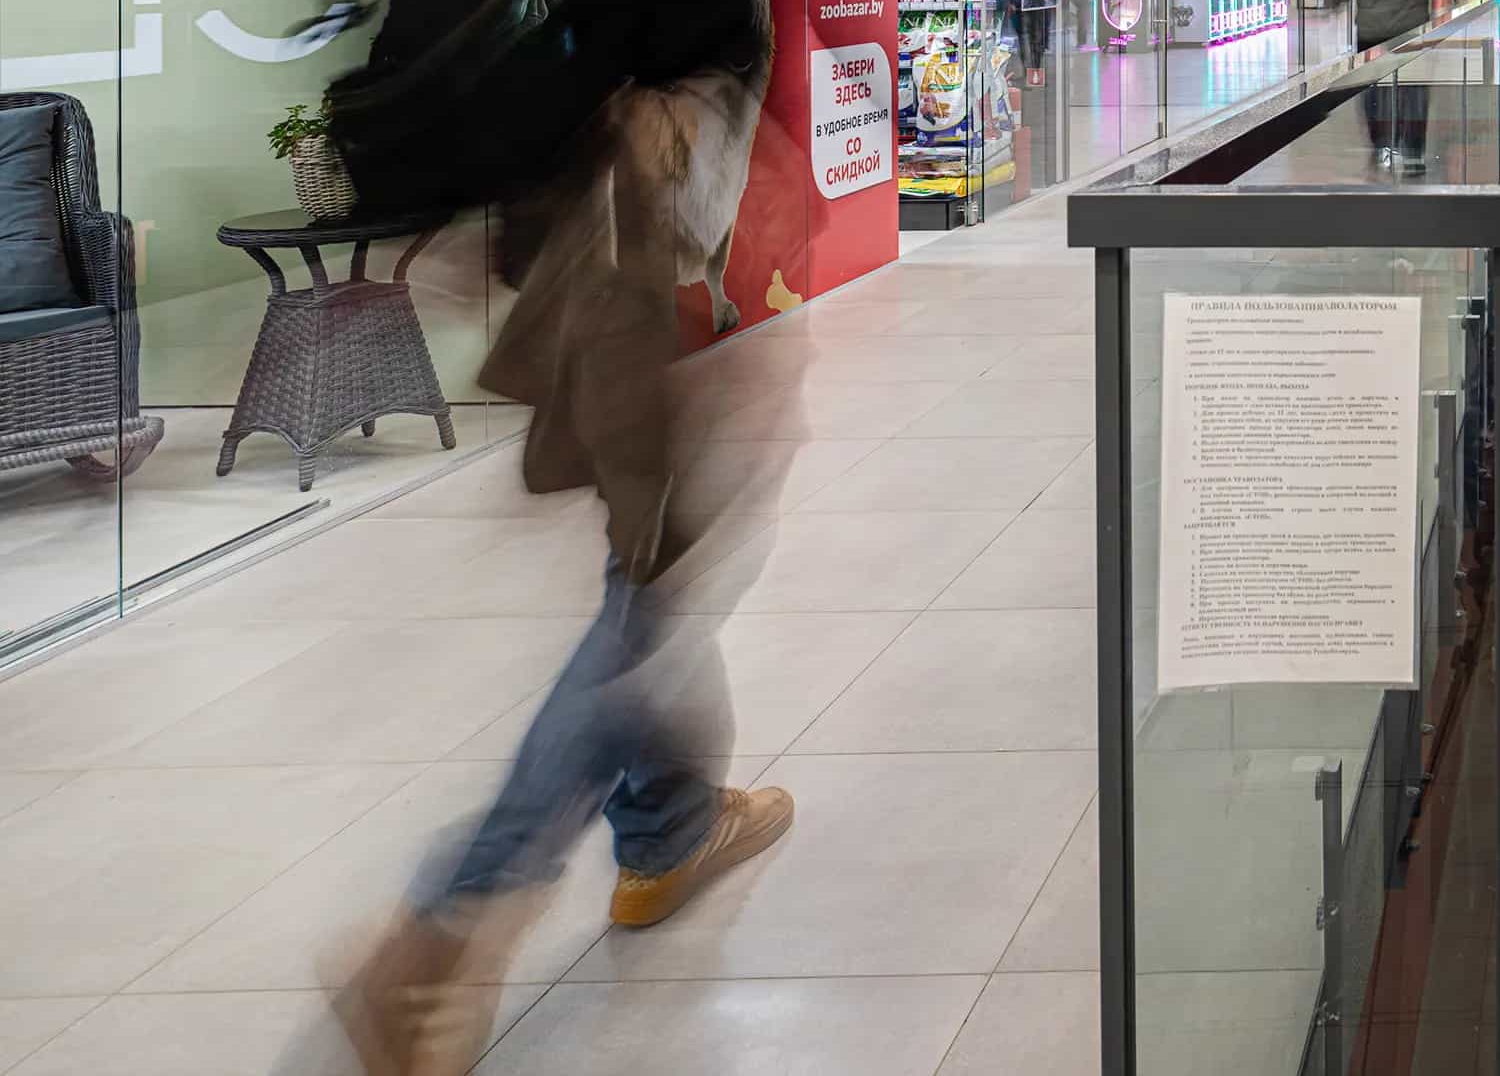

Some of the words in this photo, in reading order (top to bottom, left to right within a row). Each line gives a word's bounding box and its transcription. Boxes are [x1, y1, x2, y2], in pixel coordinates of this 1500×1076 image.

[832, 58, 875, 81] ЗАБЕРИ
[835, 83, 872, 105] ЗДЕСЬ
[816, 124, 822, 137] В
[823, 115, 862, 137] УДОБНОЕ
[864, 109, 889, 125] ВРЕМЯ
[846, 136, 862, 156] СО
[826, 149, 880, 185] СКИДКОЙ
